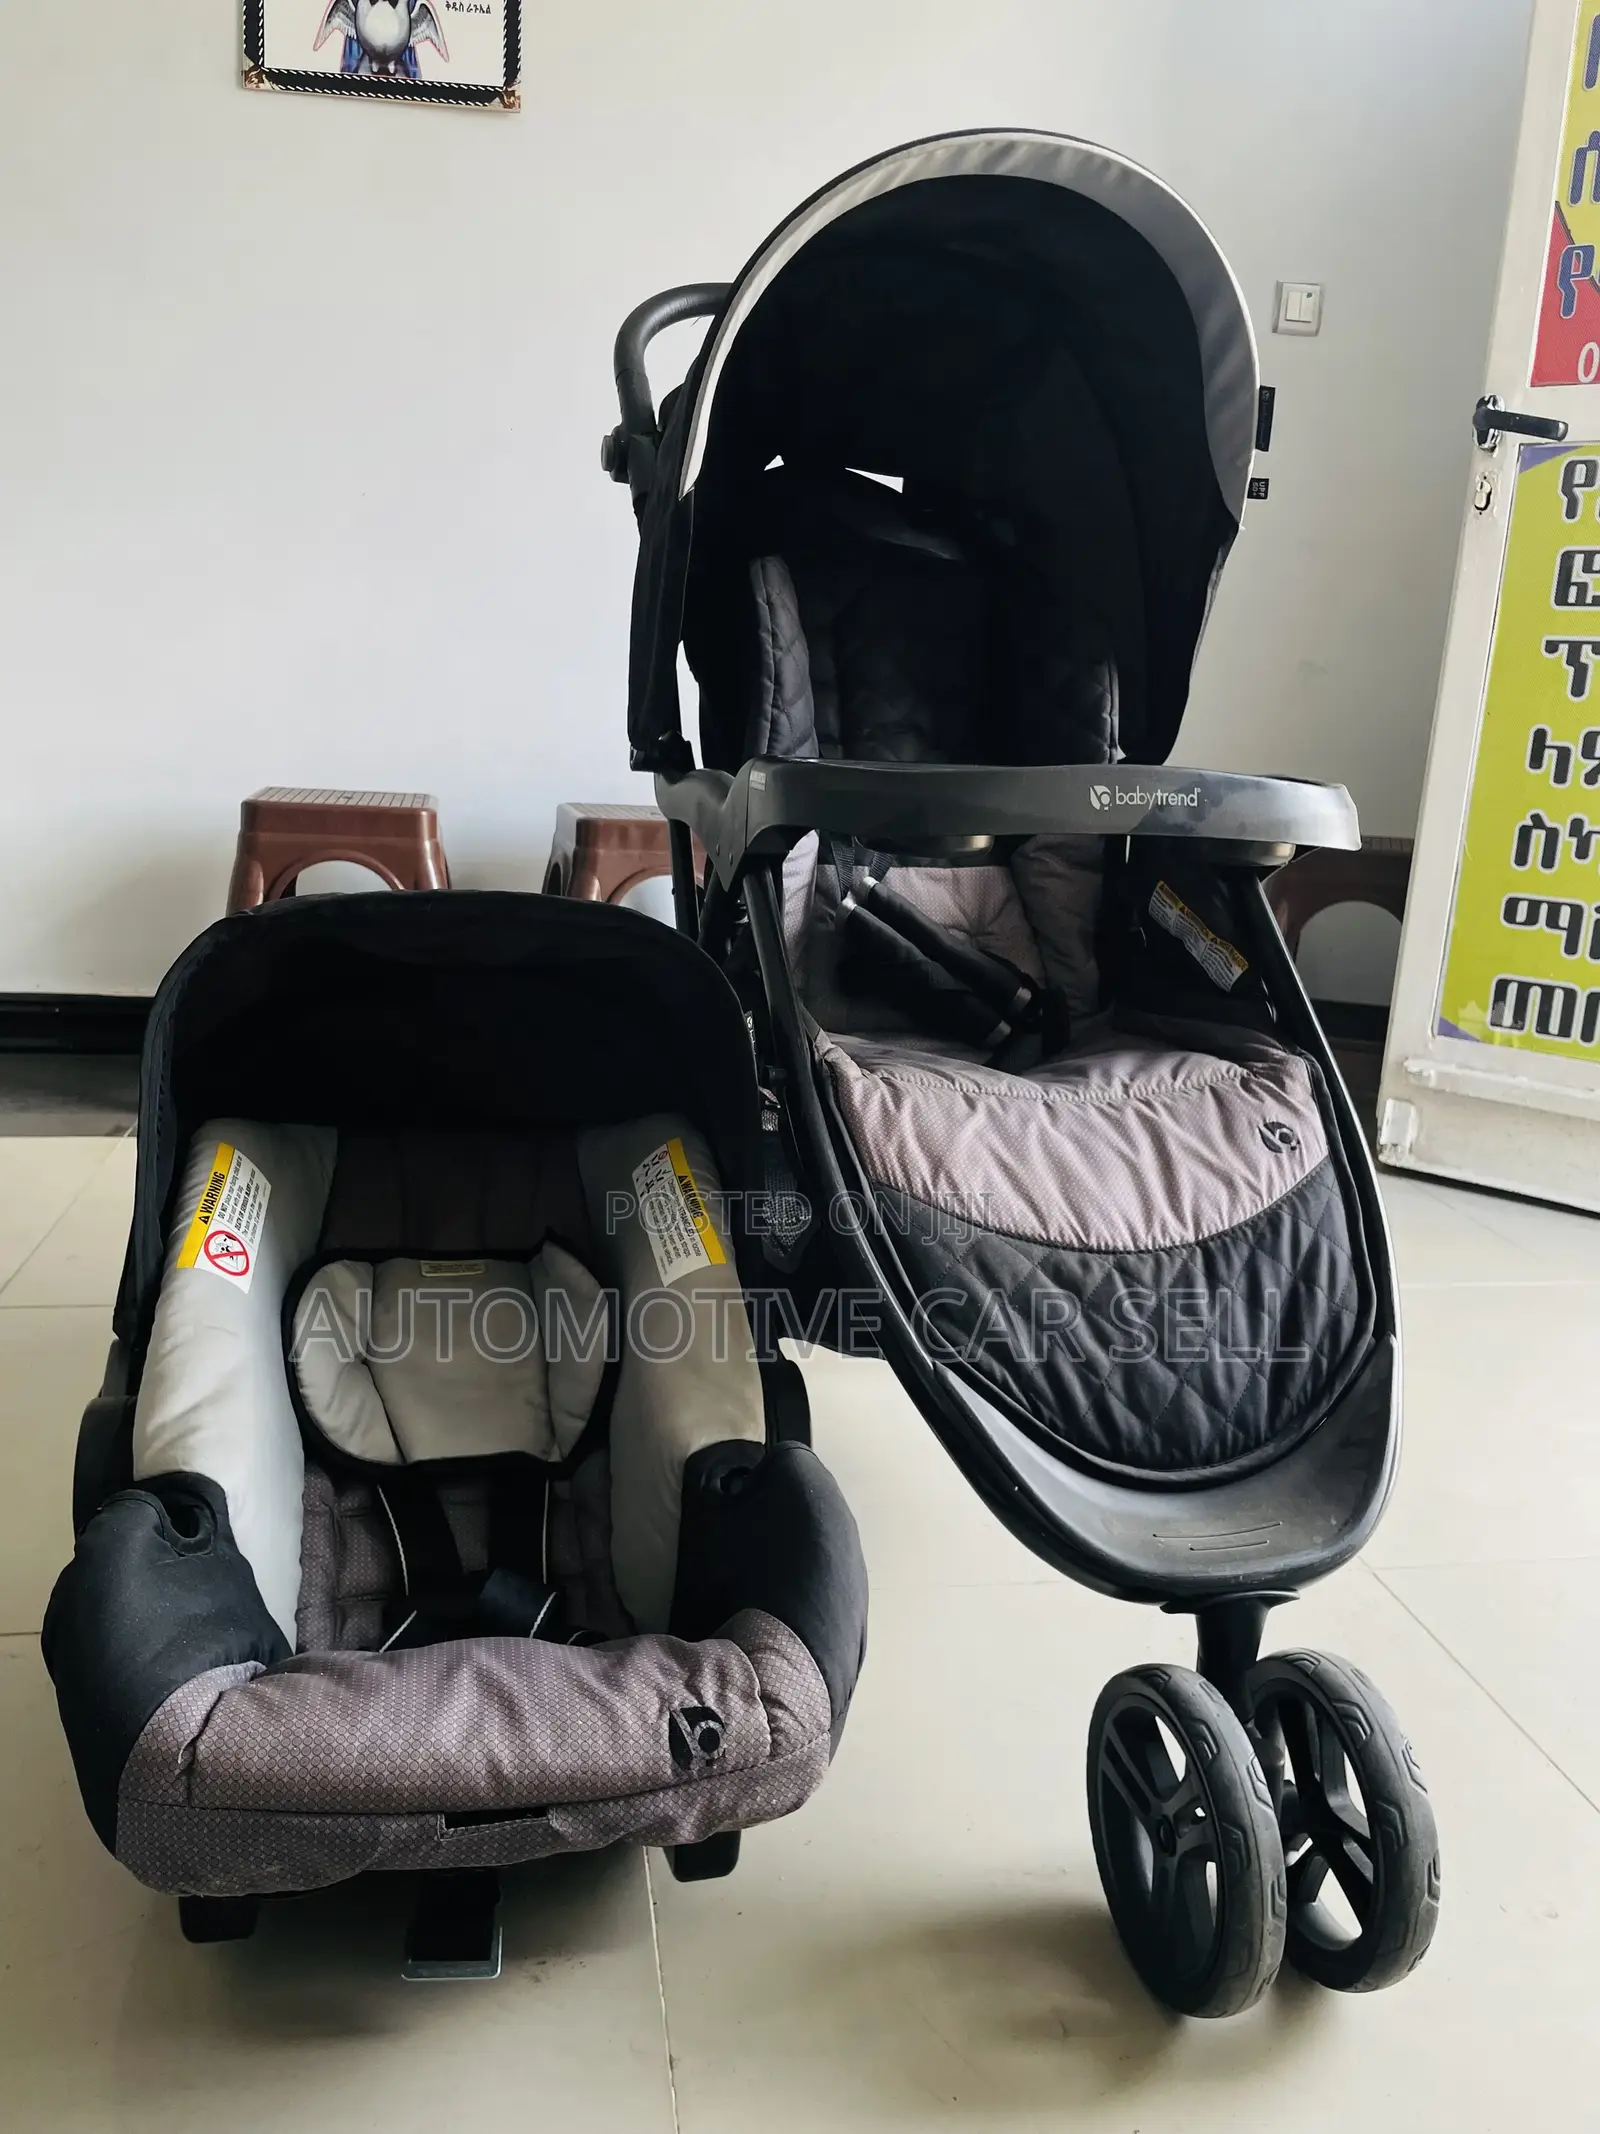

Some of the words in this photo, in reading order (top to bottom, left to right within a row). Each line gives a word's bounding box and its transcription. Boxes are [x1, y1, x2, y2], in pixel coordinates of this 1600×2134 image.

[1115, 785, 1199, 810] babytrend
[200, 1171, 225, 1214] WARNING
[680, 1180, 704, 1218] WARNING
